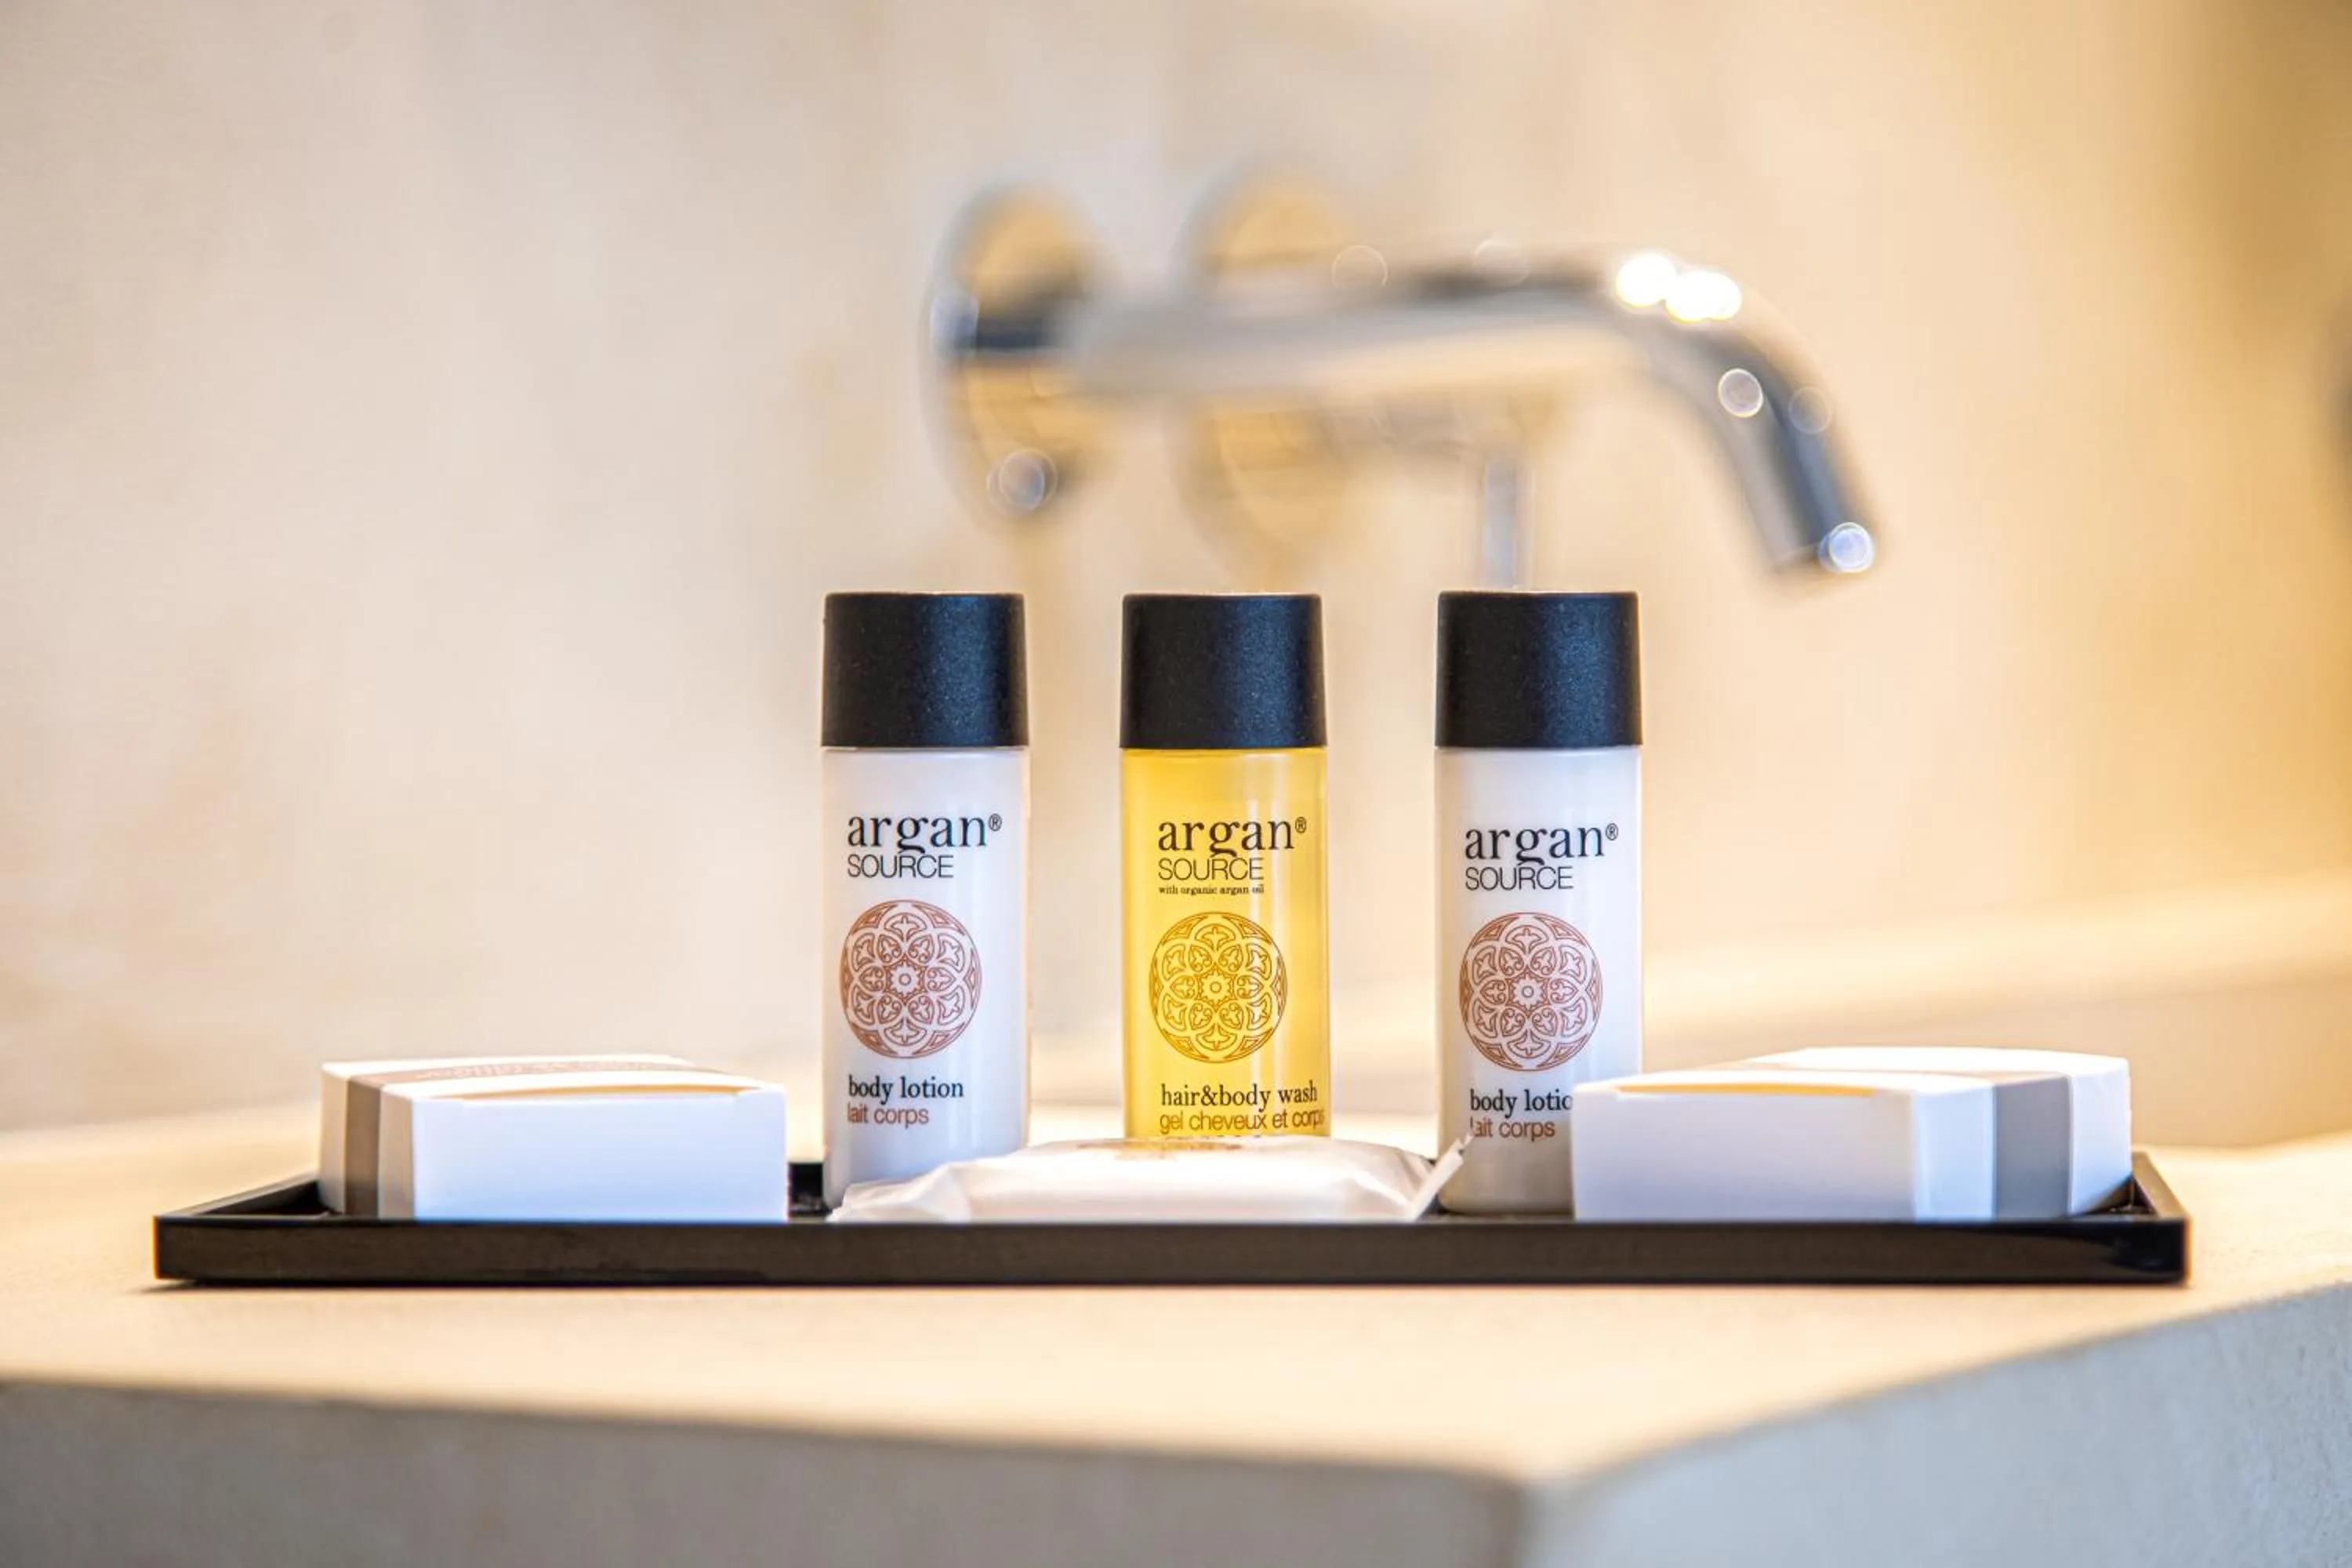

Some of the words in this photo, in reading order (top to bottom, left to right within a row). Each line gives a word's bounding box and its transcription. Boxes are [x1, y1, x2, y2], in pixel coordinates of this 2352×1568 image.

[848, 854, 954, 879] SOURCE
[1158, 858, 1265, 880] SOURCE
[1465, 866, 1573, 891] SOURCE
[1159, 884, 1178, 895] with
[1180, 885, 1218, 896] organic
[1220, 886, 1249, 896] argan
[1251, 884, 1265, 894] oil
[848, 1075, 893, 1105] body
[900, 1076, 964, 1098] lotion
[1160, 1083, 1271, 1112] hair&body
[1278, 1080, 1318, 1104] wash
[848, 1102, 869, 1123] lait
[873, 1106, 930, 1129] corps
[1470, 1088, 1518, 1119] body
[1524, 1088, 1573, 1111] lotio
[1160, 1110, 1184, 1134] gel
[1189, 1109, 1268, 1131] cheveux
[1272, 1109, 1288, 1129] et
[1499, 1120, 1556, 1142] corps
